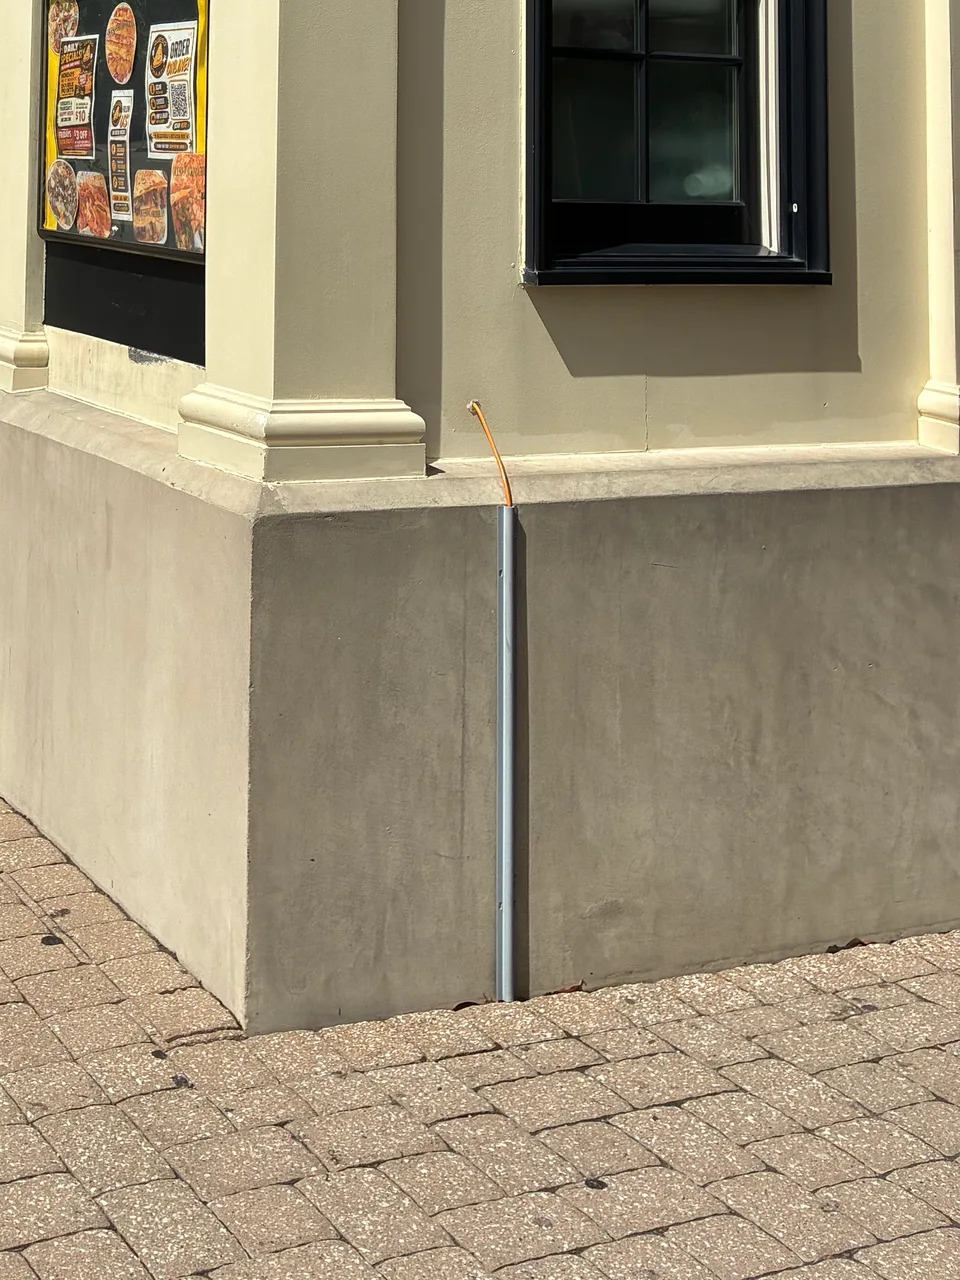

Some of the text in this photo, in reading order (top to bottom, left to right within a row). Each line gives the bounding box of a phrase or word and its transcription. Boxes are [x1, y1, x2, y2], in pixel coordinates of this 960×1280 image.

[63, 42, 79, 53] DAILY
[170, 38, 191, 59] ORDER
[75, 110, 86, 122] $10
